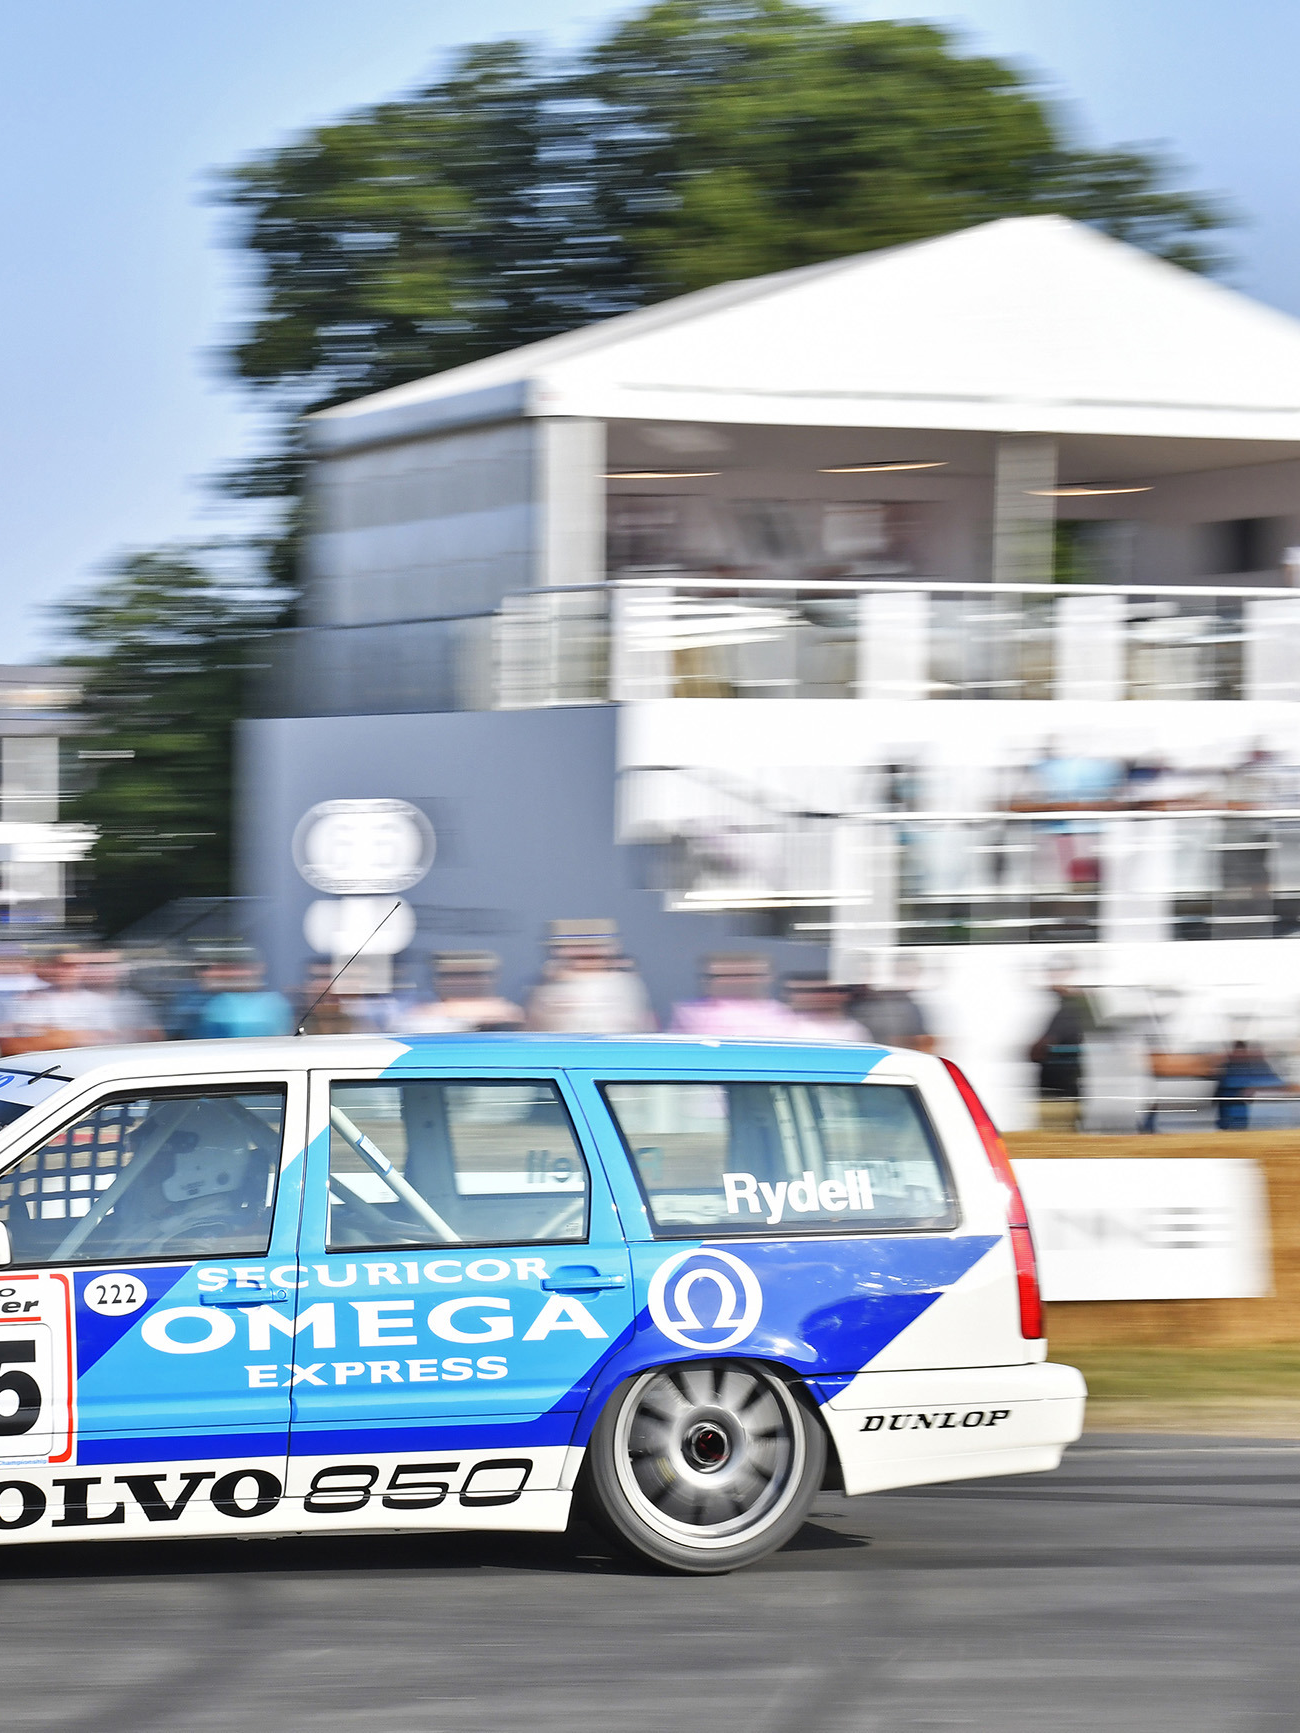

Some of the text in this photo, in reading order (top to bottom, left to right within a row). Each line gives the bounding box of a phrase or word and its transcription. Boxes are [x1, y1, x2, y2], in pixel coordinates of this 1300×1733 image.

[722, 1169, 875, 1225] Rydell
[197, 1257, 552, 1291] SECURICOR
[97, 1283, 137, 1305] 222
[140, 1295, 610, 1355] OMEGA
[243, 1356, 508, 1388] EXPRESS
[859, 1409, 1012, 1432] DUNLOP
[303, 1458, 534, 1514] 850
